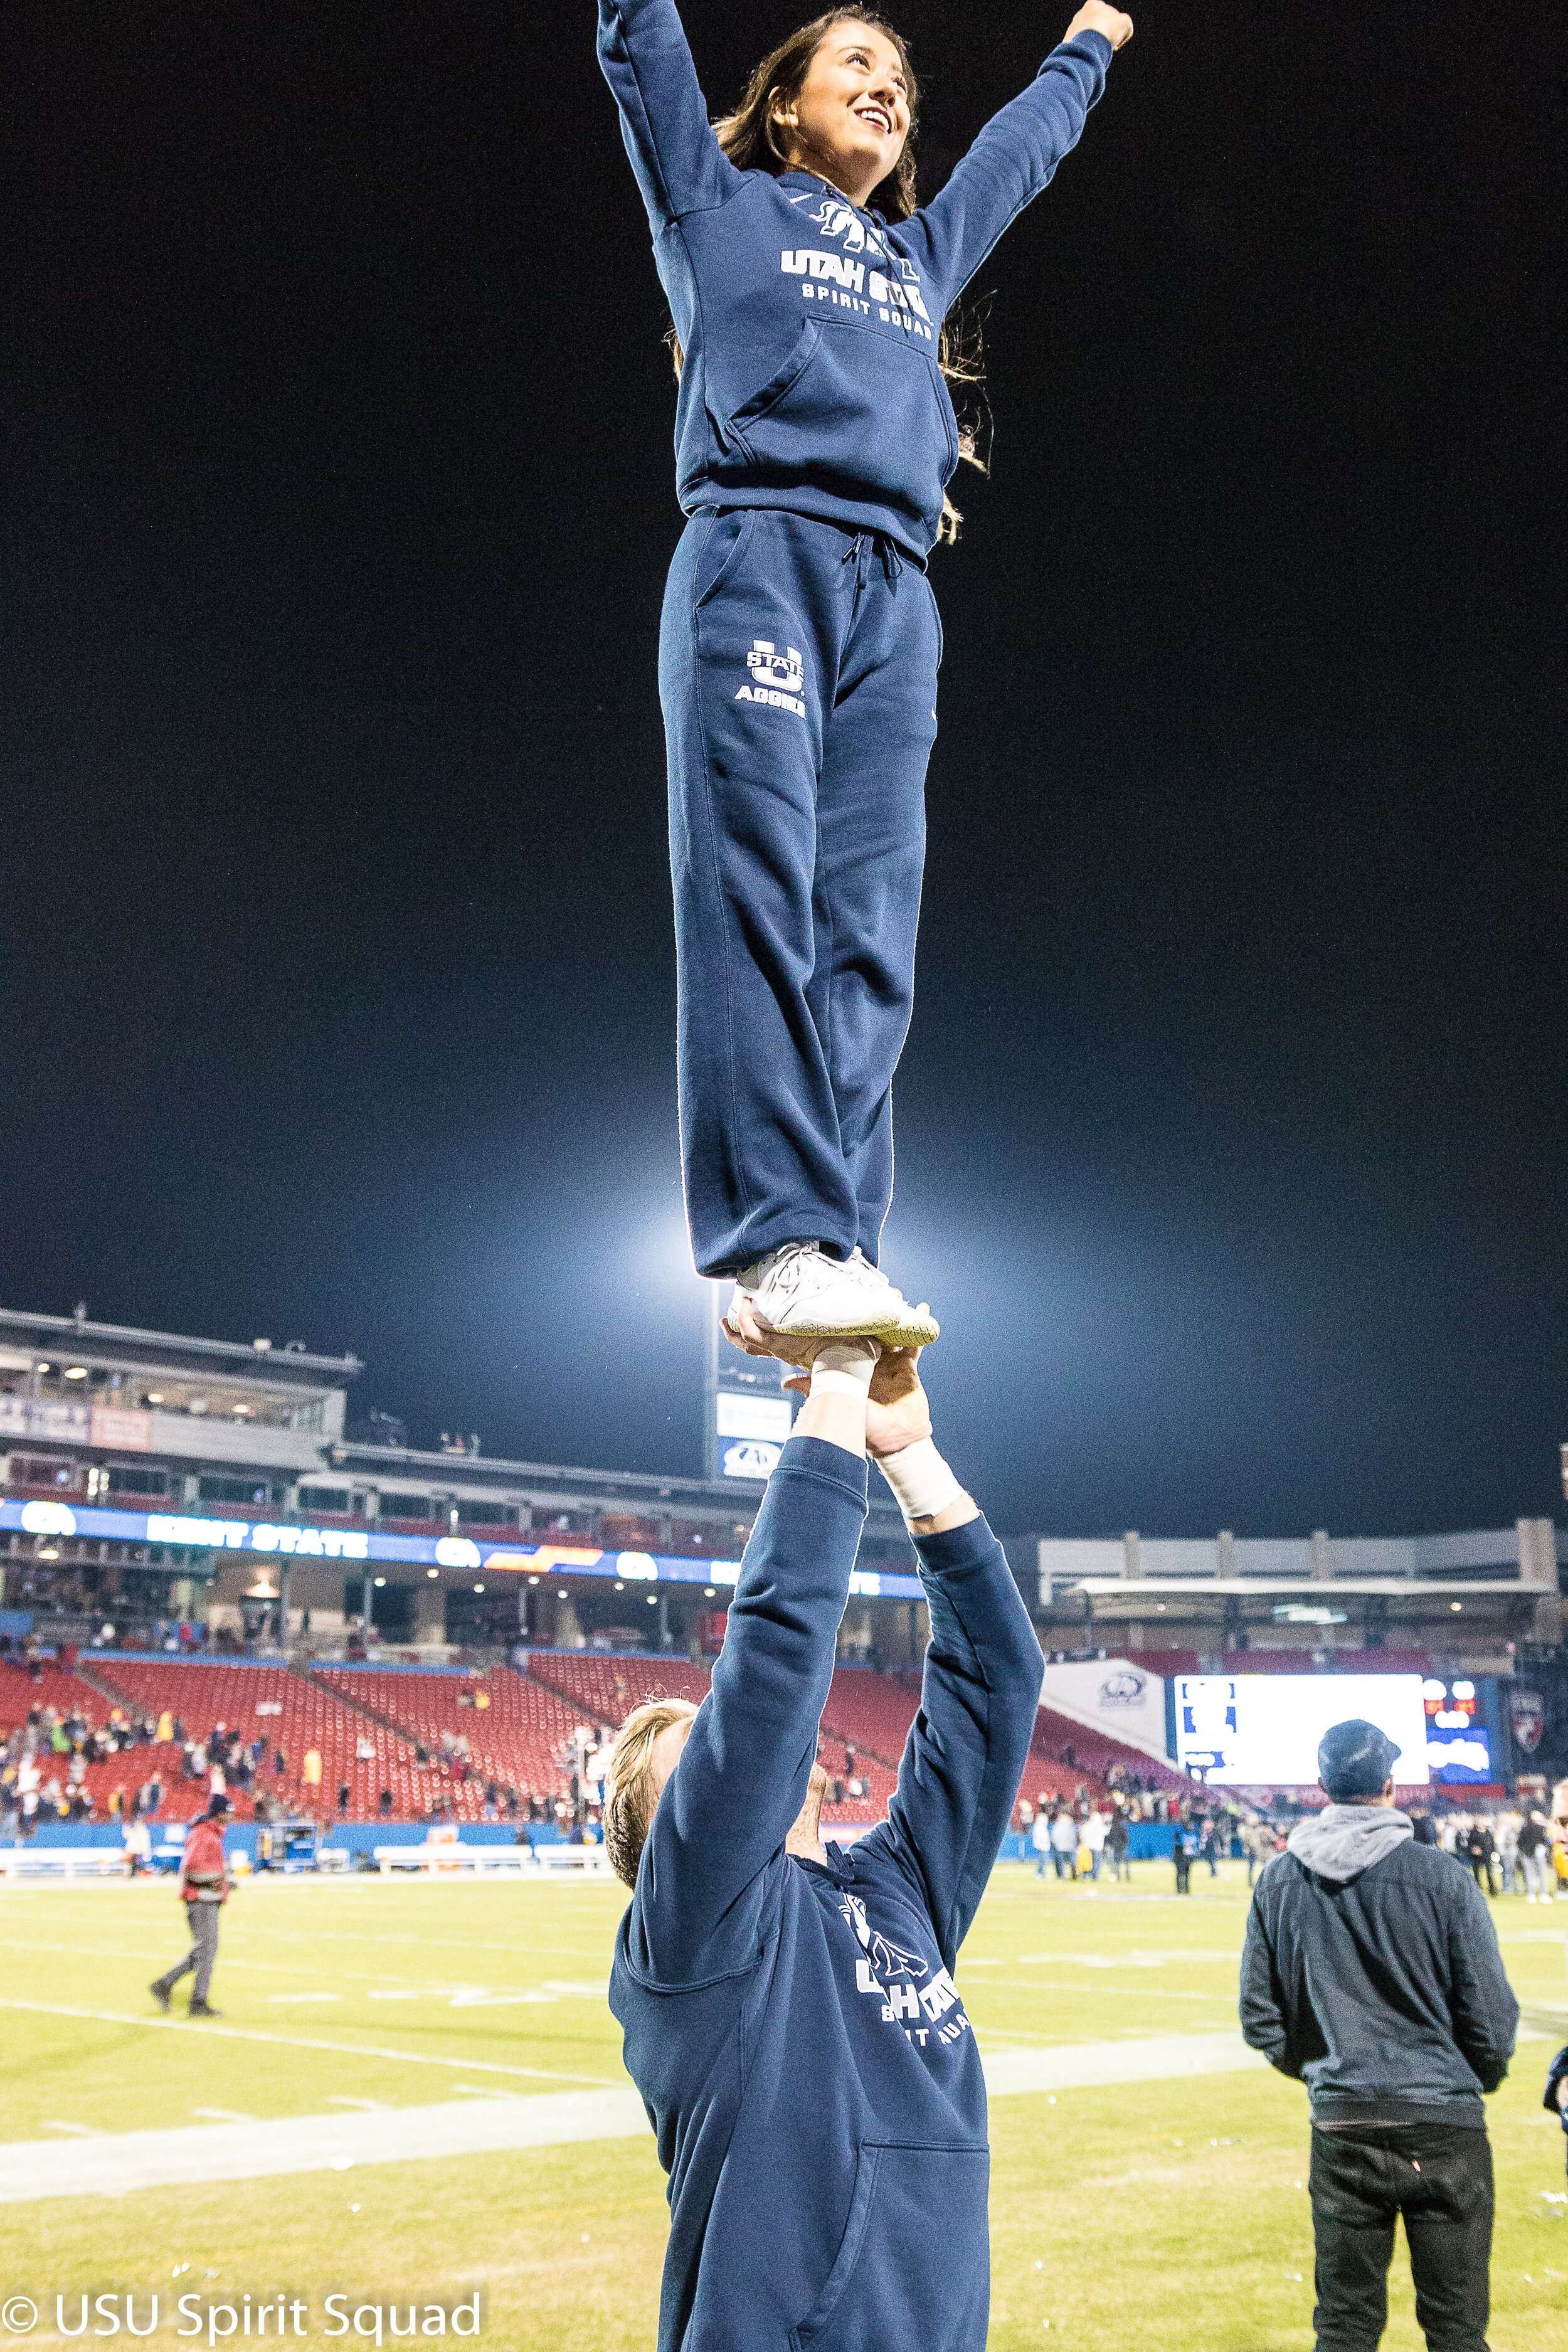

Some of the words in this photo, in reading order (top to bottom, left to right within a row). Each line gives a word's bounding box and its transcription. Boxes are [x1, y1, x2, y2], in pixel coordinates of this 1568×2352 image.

[781, 249, 865, 294] UTAH
[802, 283, 871, 315] SPIRIT
[879, 307, 932, 341] SQUAD
[746, 651, 804, 682] STATE
[252, 1523, 369, 1559] STATE
